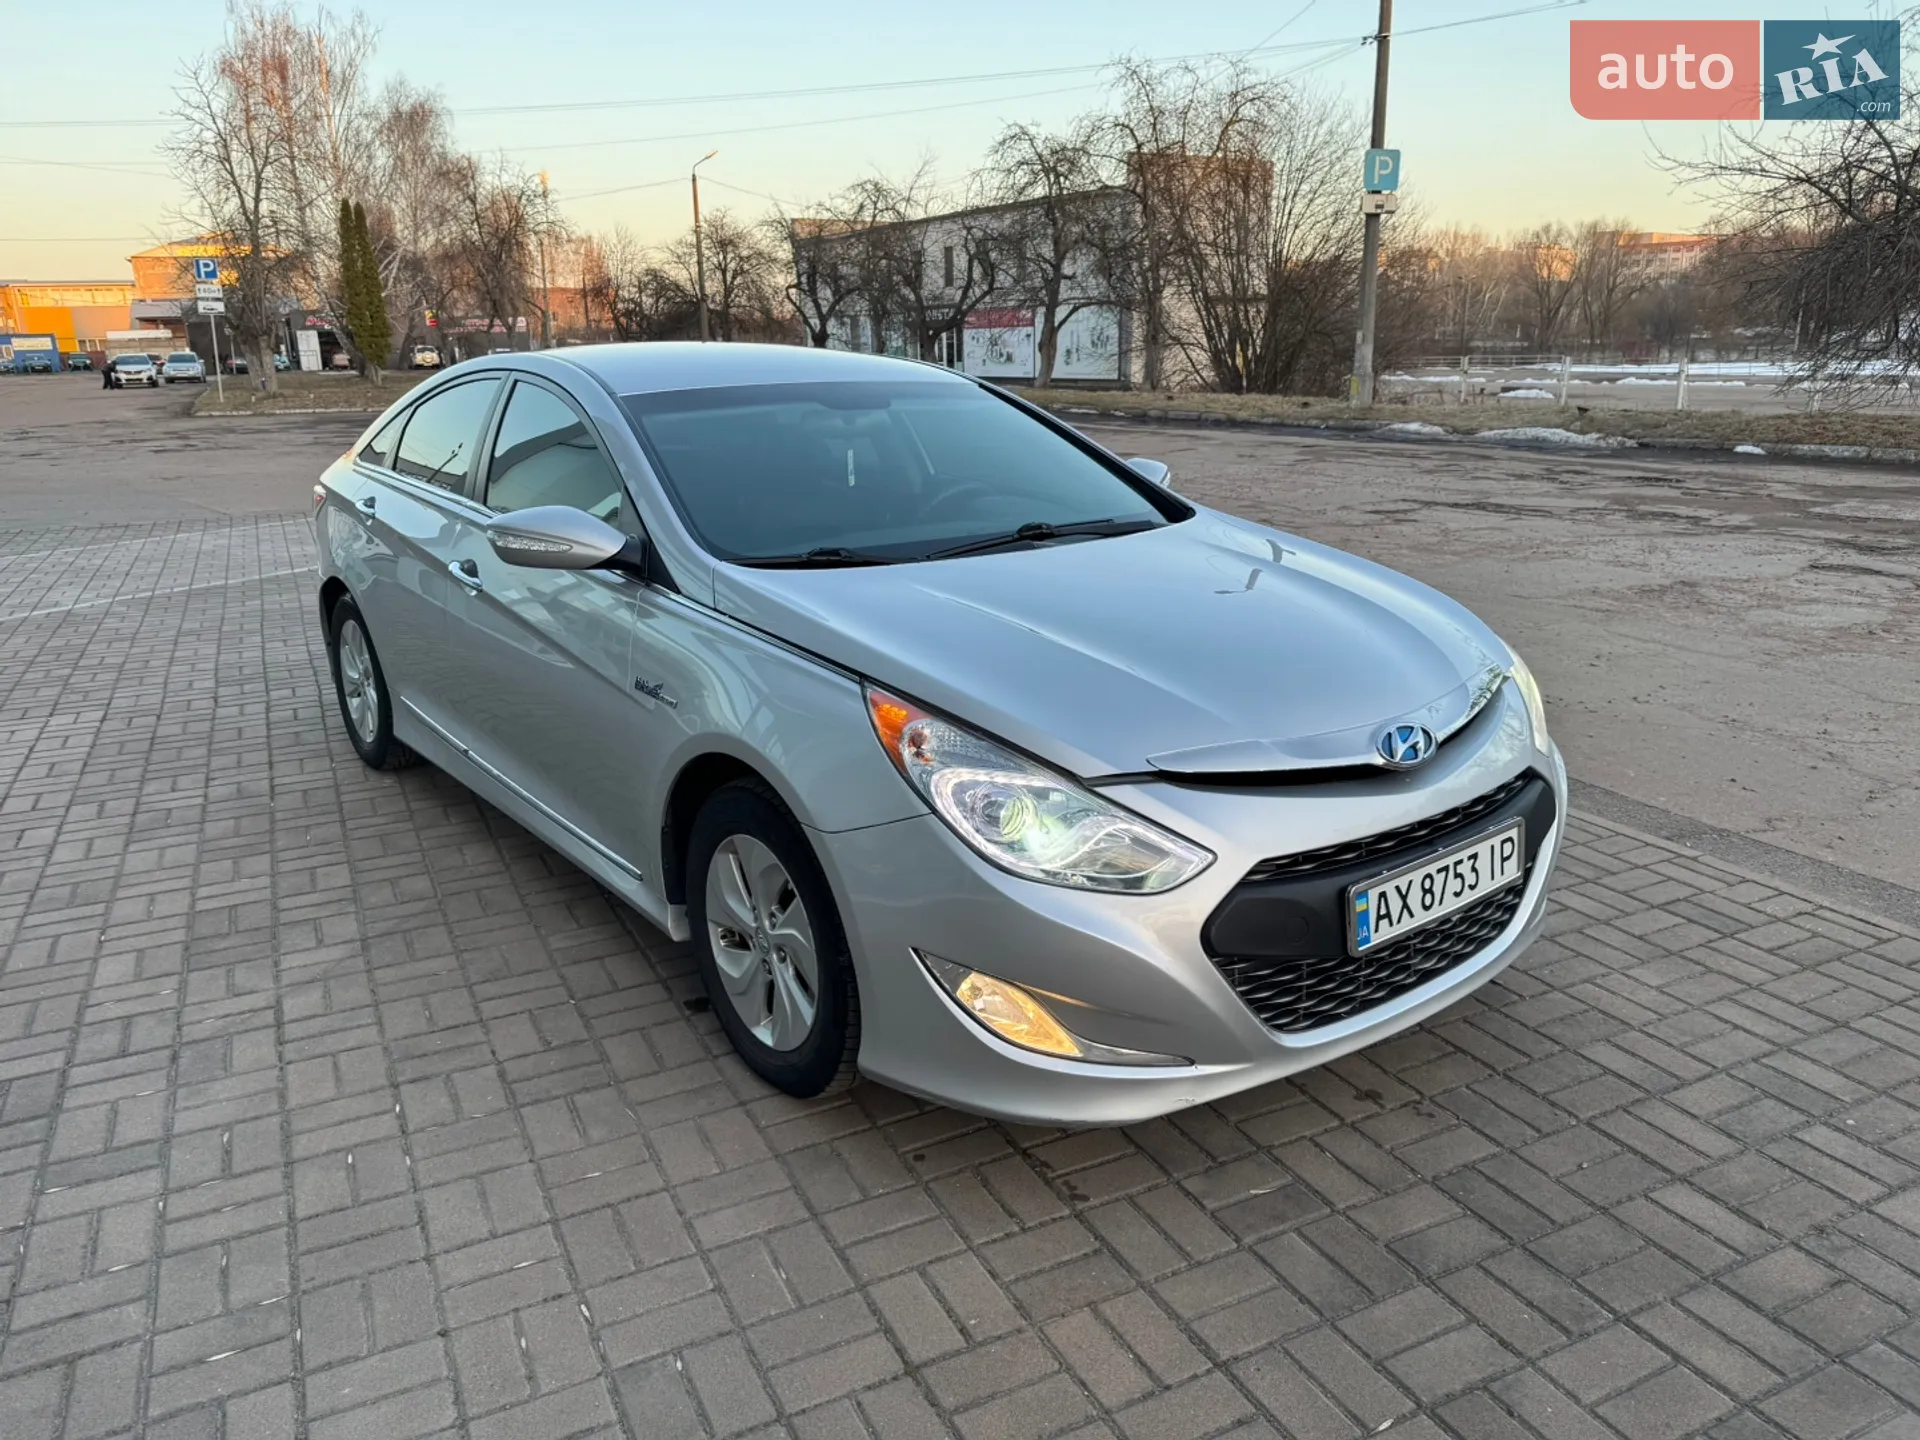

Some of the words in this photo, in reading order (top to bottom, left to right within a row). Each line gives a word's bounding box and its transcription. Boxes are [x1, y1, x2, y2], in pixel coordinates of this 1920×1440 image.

[1373, 155, 1394, 185] P
[199, 260, 215, 279] P
[1374, 879, 1415, 934] AX
[1420, 852, 1479, 912] 8753
[1490, 836, 1515, 881] IP
